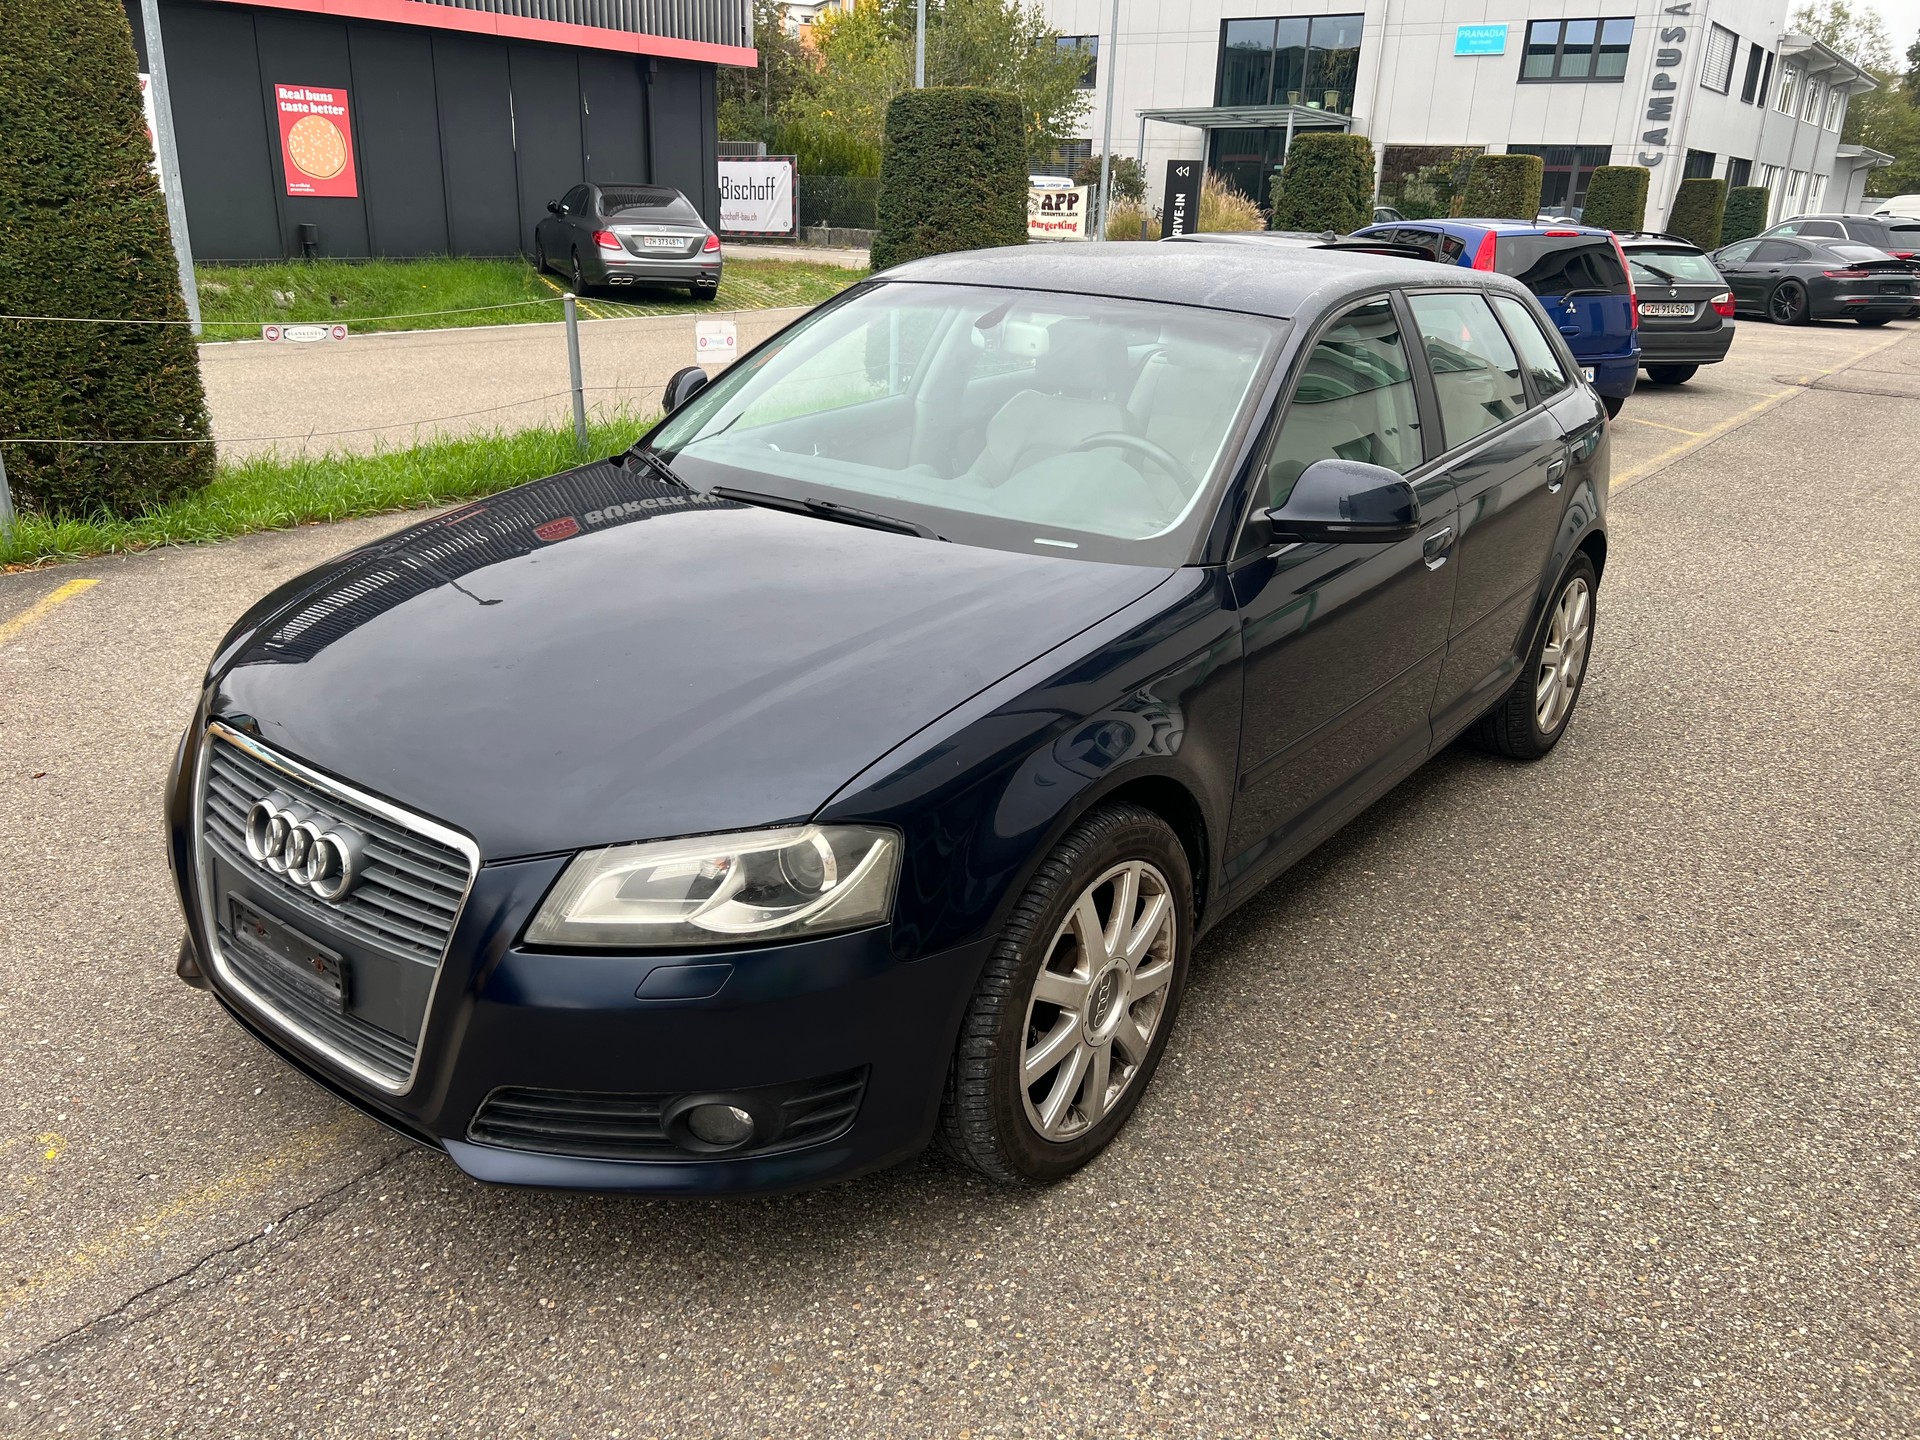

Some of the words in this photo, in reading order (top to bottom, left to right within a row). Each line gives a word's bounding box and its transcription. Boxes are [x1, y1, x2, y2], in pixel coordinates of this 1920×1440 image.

[1458, 28, 1505, 38] PRANADIA
[278, 87, 305, 100] Real
[305, 89, 334, 103] buns
[280, 101, 310, 113] taste
[310, 102, 345, 116] better
[721, 176, 776, 200] Bischoff
[1041, 193, 1080, 211] APP
[1172, 193, 1187, 236] RIVE-IN
